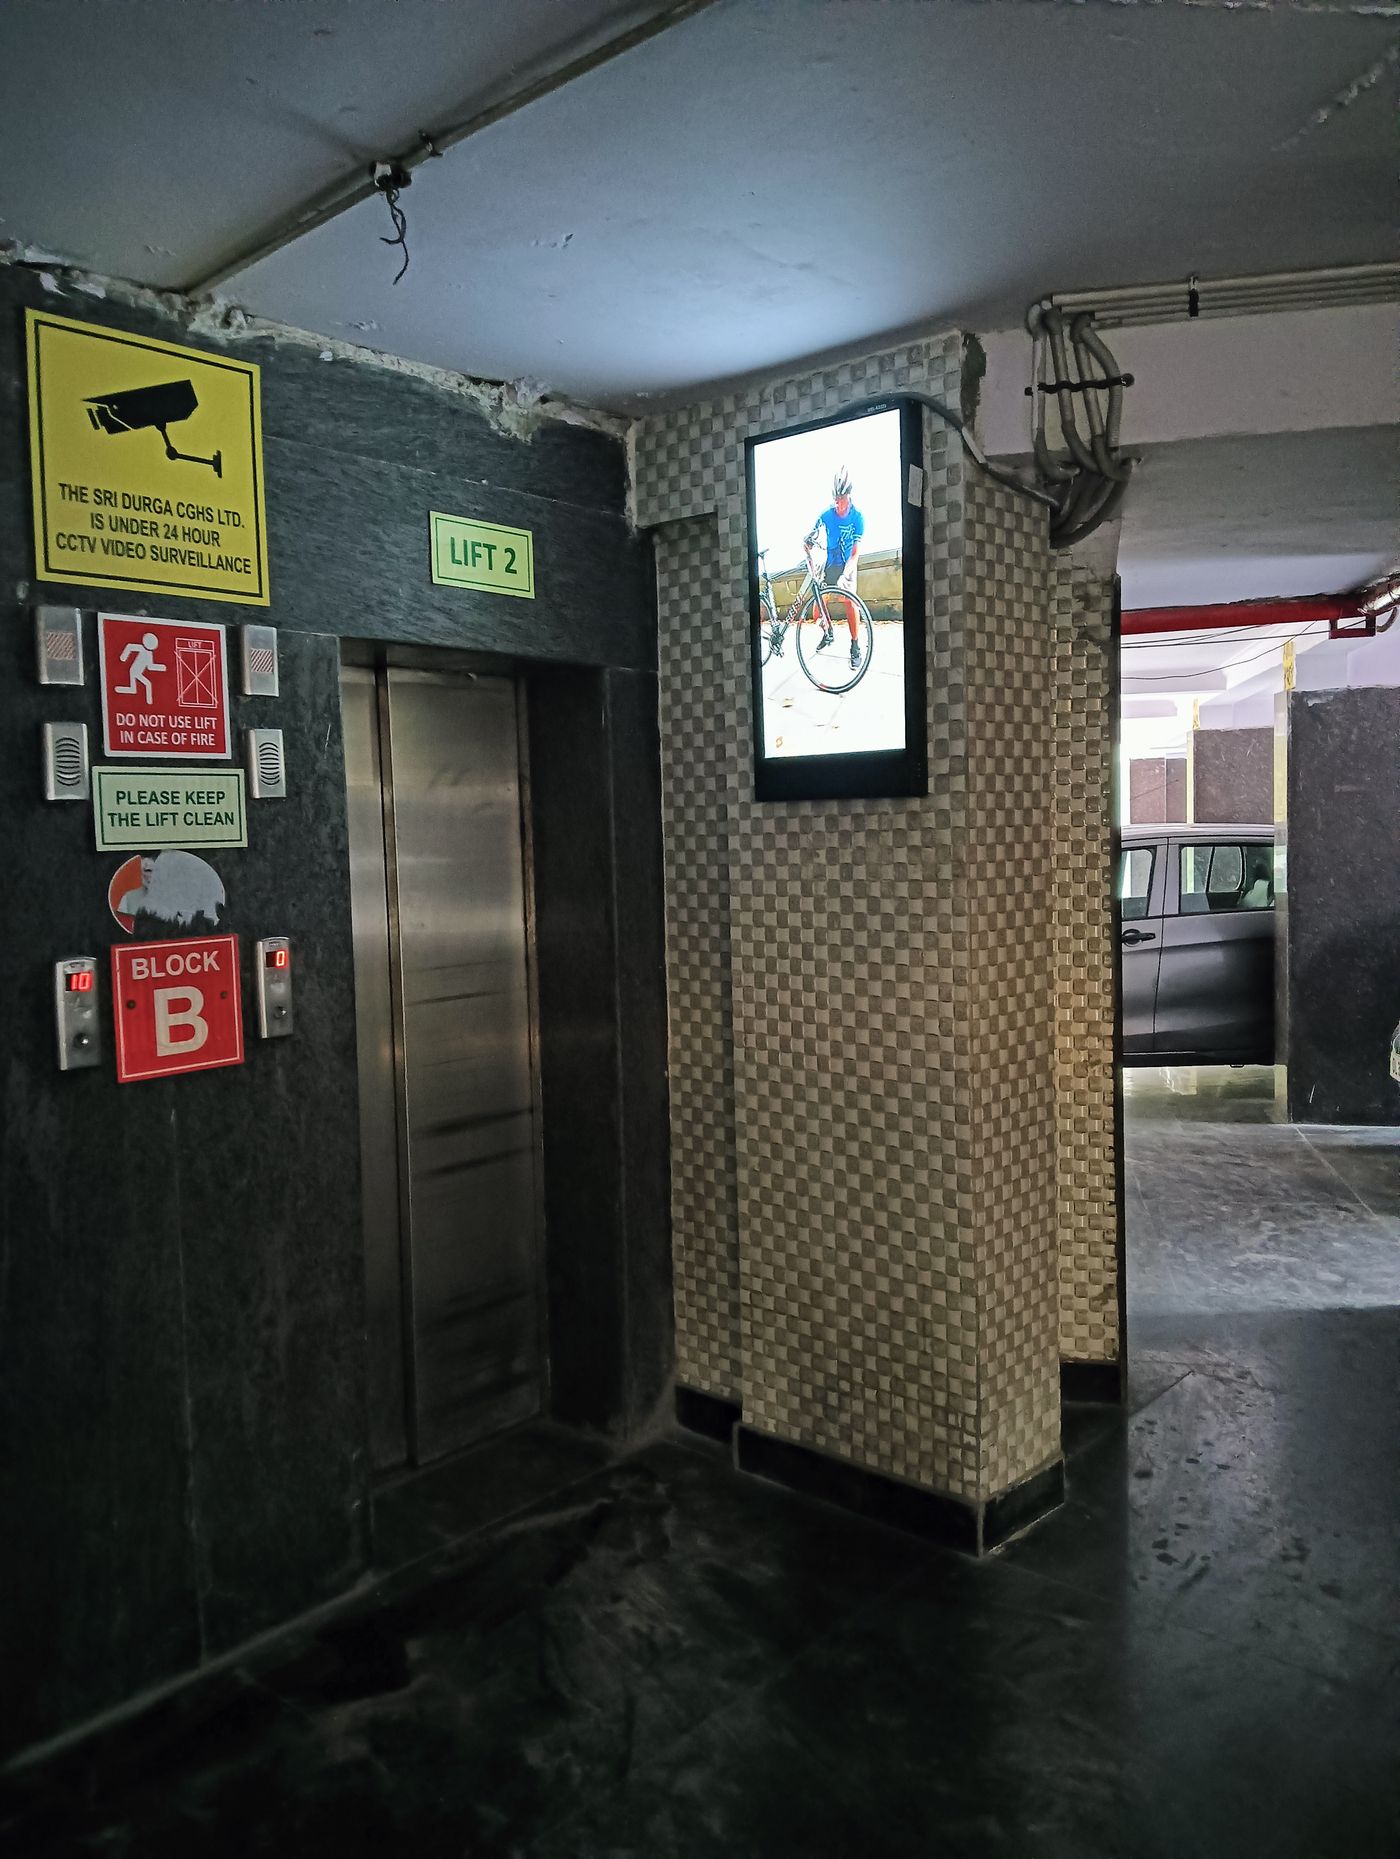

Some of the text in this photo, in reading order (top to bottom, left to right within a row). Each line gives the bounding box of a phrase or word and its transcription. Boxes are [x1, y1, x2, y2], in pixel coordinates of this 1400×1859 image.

[58, 482, 245, 529] THE SRI DURGA CGHS LTD.
[90, 512, 221, 547] IS UNDER 24 HOUR
[55, 532, 252, 575] CCTV VIDEO SURVEILLANCE
[450, 536, 517, 574] LIFT 2
[188, 641, 202, 649] LIFT
[116, 713, 218, 730] DO NOT USE LIFT
[120, 730, 216, 746] IN CASE OF FIRE
[116, 790, 226, 806] PLEASE KEEP
[107, 811, 235, 827] THE LIFT CLEAN
[131, 950, 220, 980] BLOCK
[276, 950, 285, 967] 0
[71, 972, 91, 990] 10
[153, 986, 209, 1057] B
